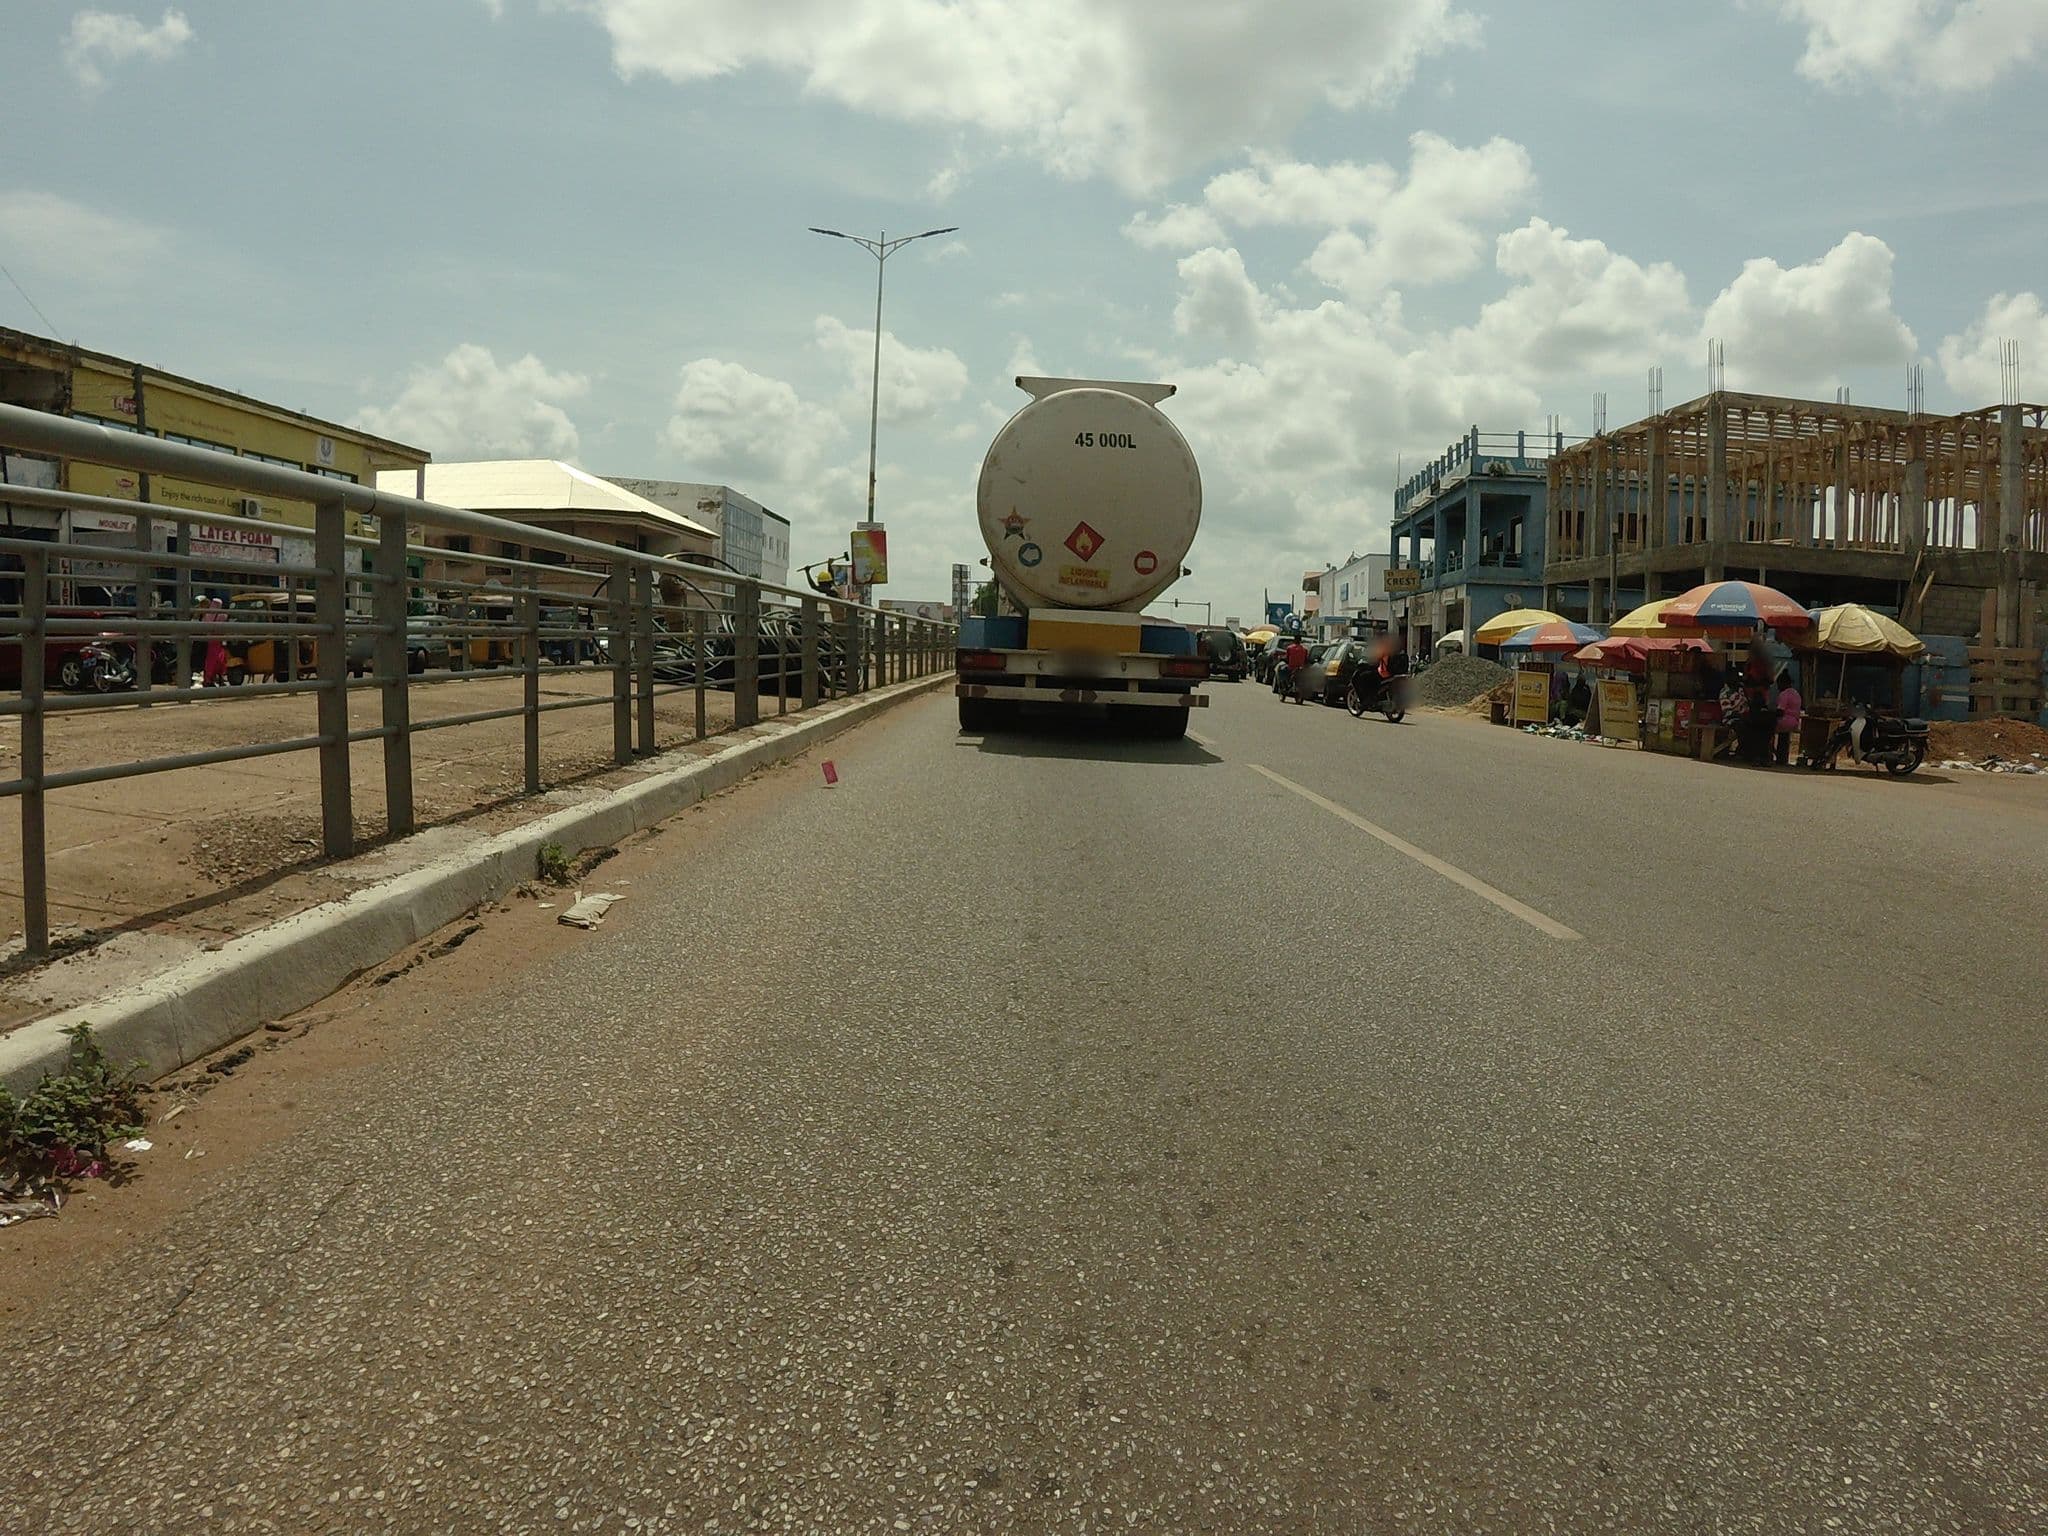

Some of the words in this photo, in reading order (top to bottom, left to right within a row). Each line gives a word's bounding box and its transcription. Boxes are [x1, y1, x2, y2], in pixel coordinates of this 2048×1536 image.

[1074, 432, 1094, 448] 45
[1099, 433, 1137, 449] 000L
[161, 487, 179, 502] Enjoy
[180, 492, 190, 502] the
[199, 525, 237, 542] LATEX
[240, 531, 273, 546] FOAM
[1386, 577, 1417, 586] CREST
